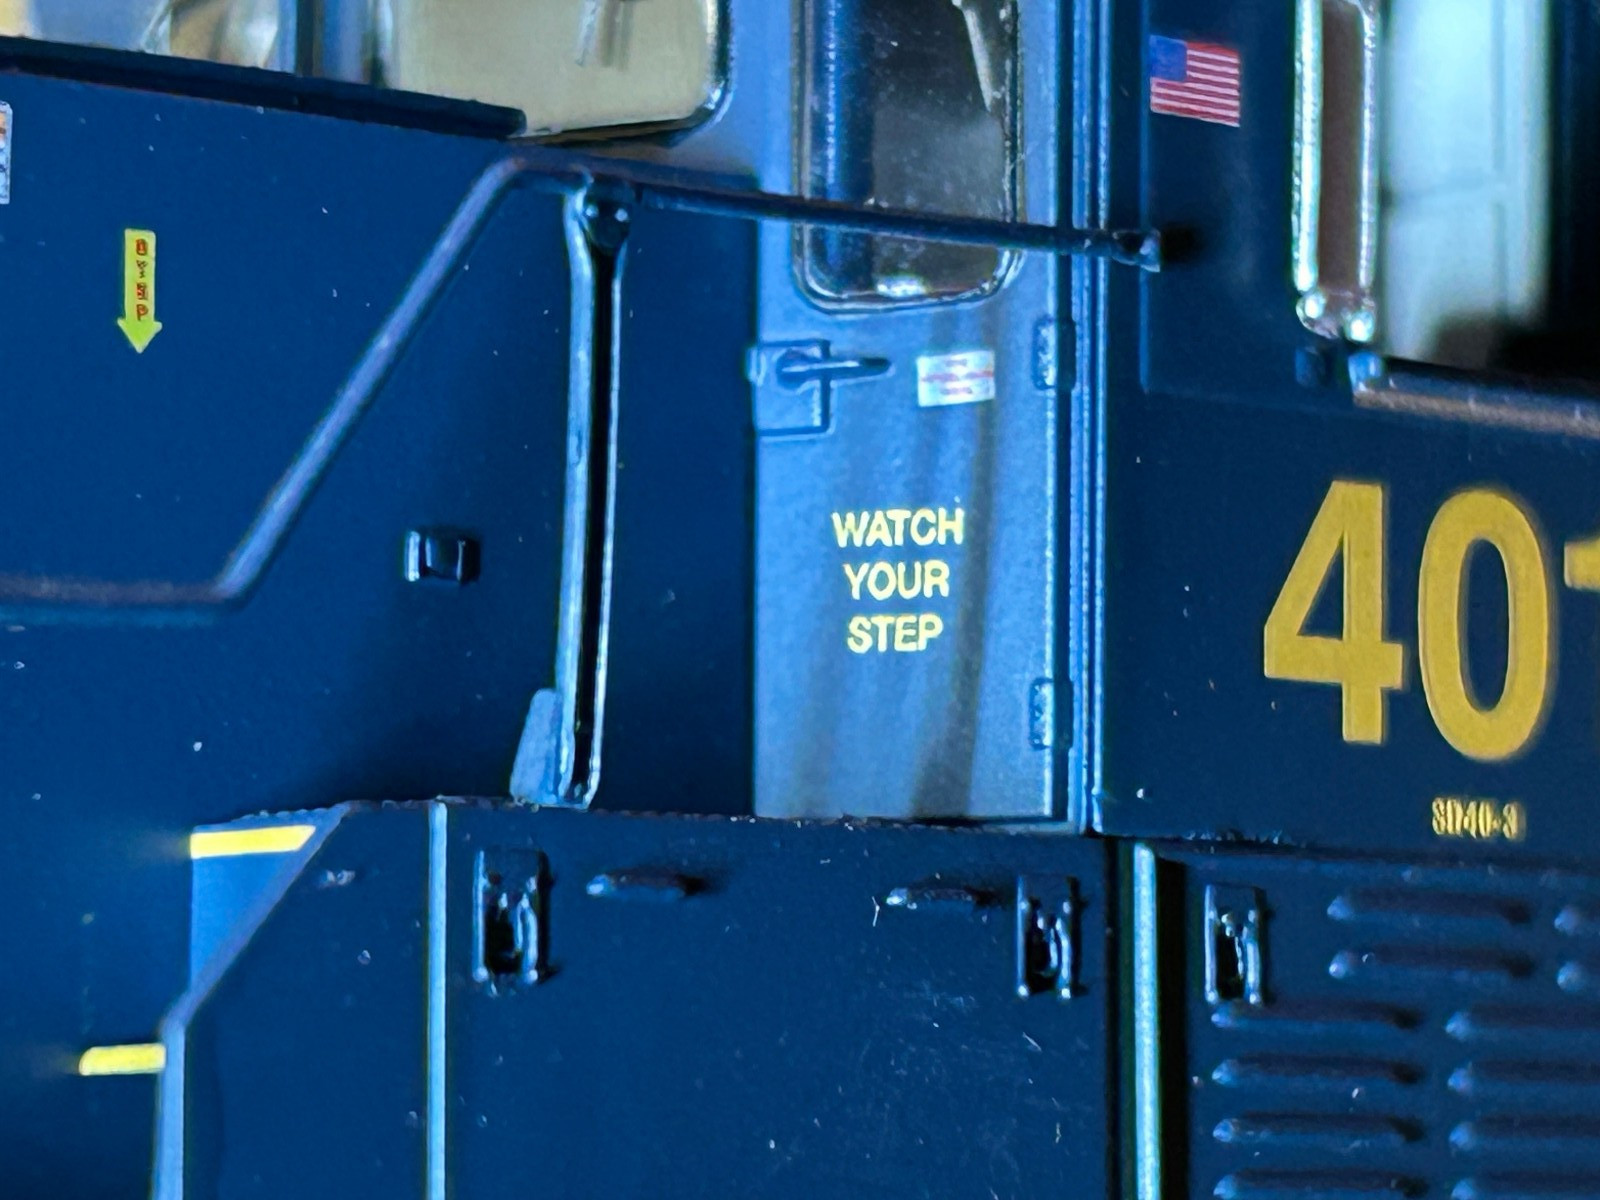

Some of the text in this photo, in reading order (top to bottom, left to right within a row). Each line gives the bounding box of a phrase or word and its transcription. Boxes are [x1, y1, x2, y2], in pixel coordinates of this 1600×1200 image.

[831, 507, 965, 548] WATCH
[843, 559, 950, 600] YOUR
[847, 612, 943, 654] STEP
[1263, 479, 1600, 761] 40
